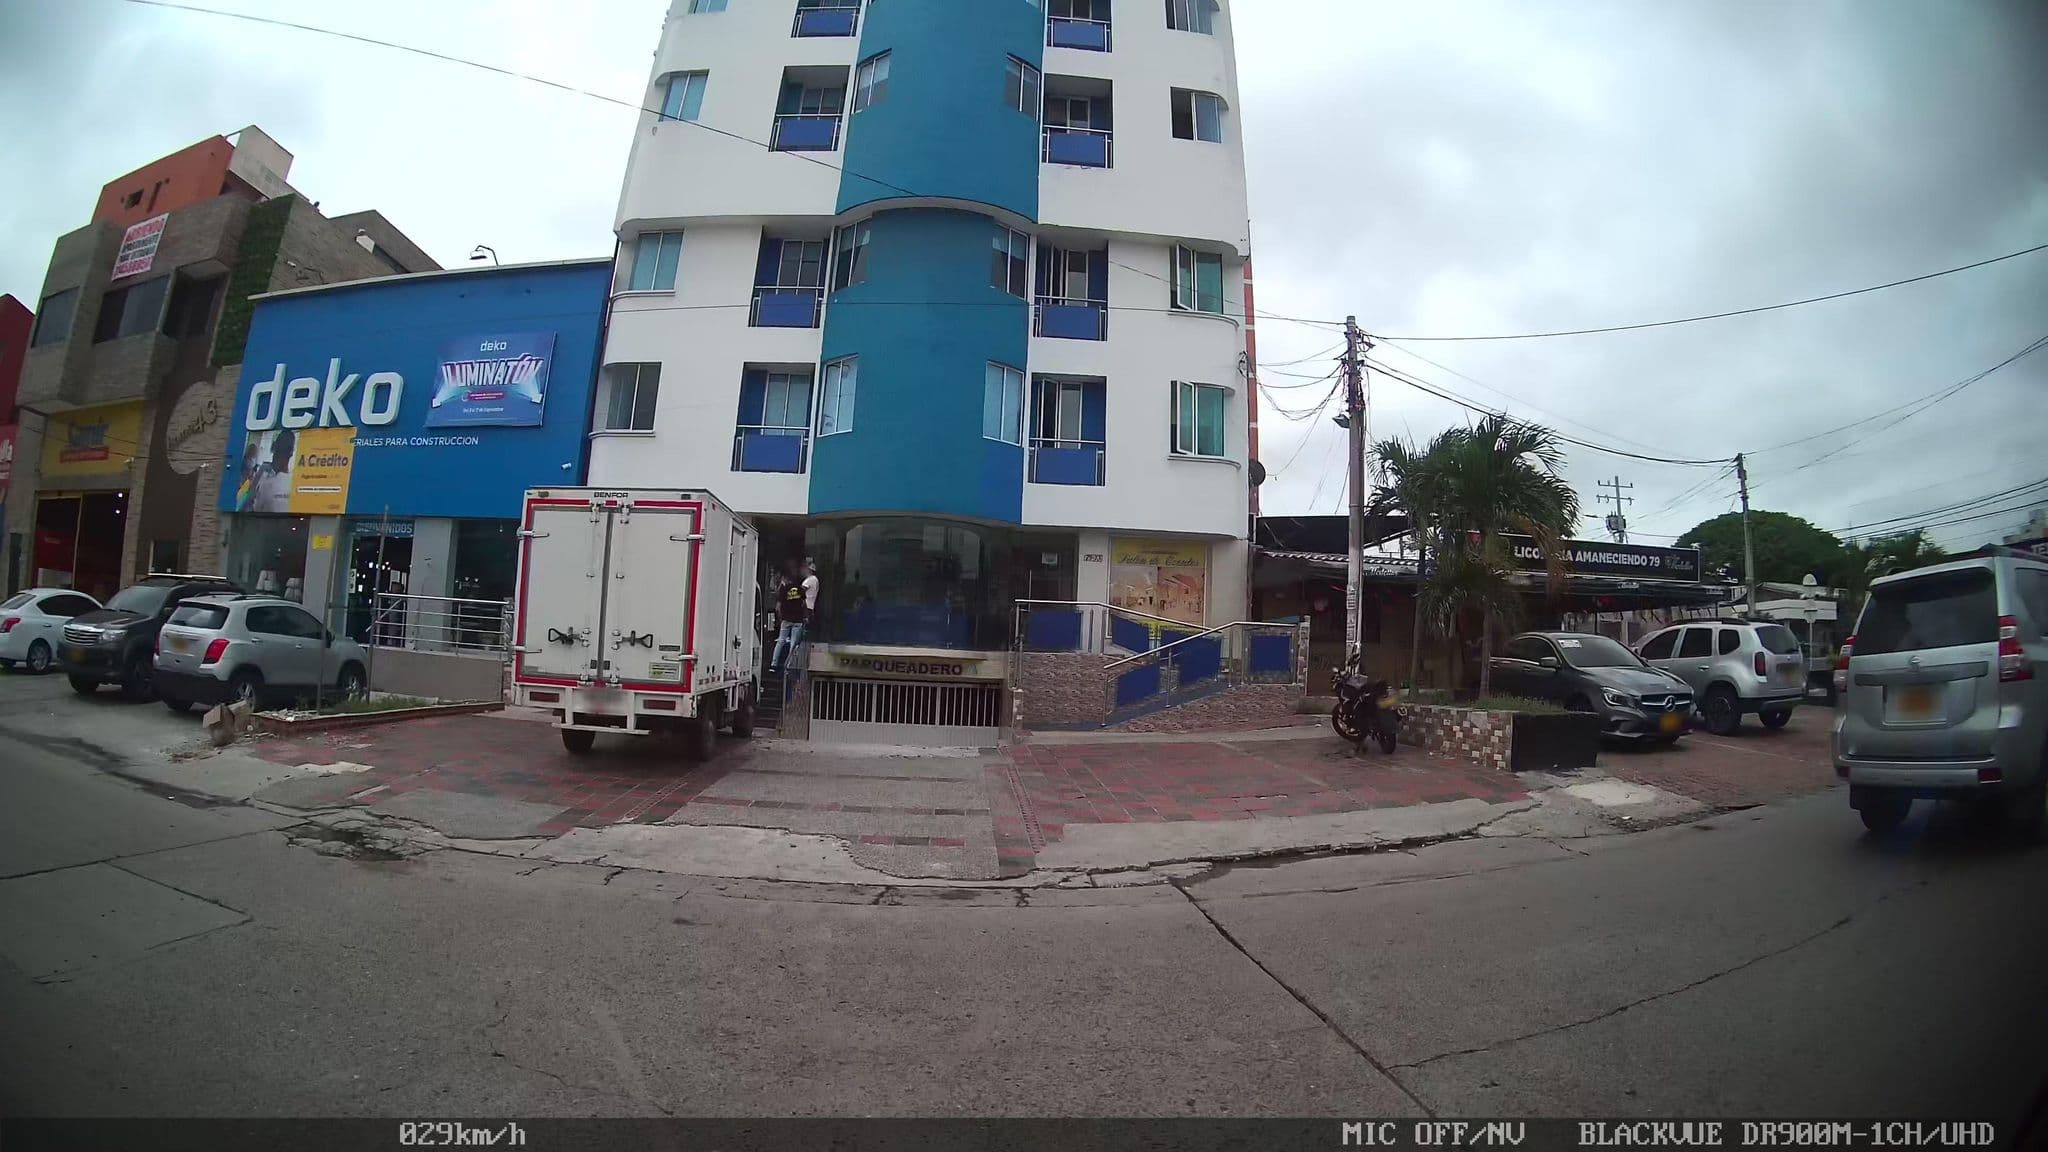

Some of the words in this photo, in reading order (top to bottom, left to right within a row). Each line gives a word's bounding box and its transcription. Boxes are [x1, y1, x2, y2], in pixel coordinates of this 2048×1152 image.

[480, 340, 507, 351] deko
[246, 357, 404, 431] deko
[352, 437, 383, 447] ERIALES
[385, 437, 408, 446] PARA
[298, 454, 305, 467] A
[1574, 550, 1648, 567] AMANECIENDO
[1648, 556, 1661, 568] 79
